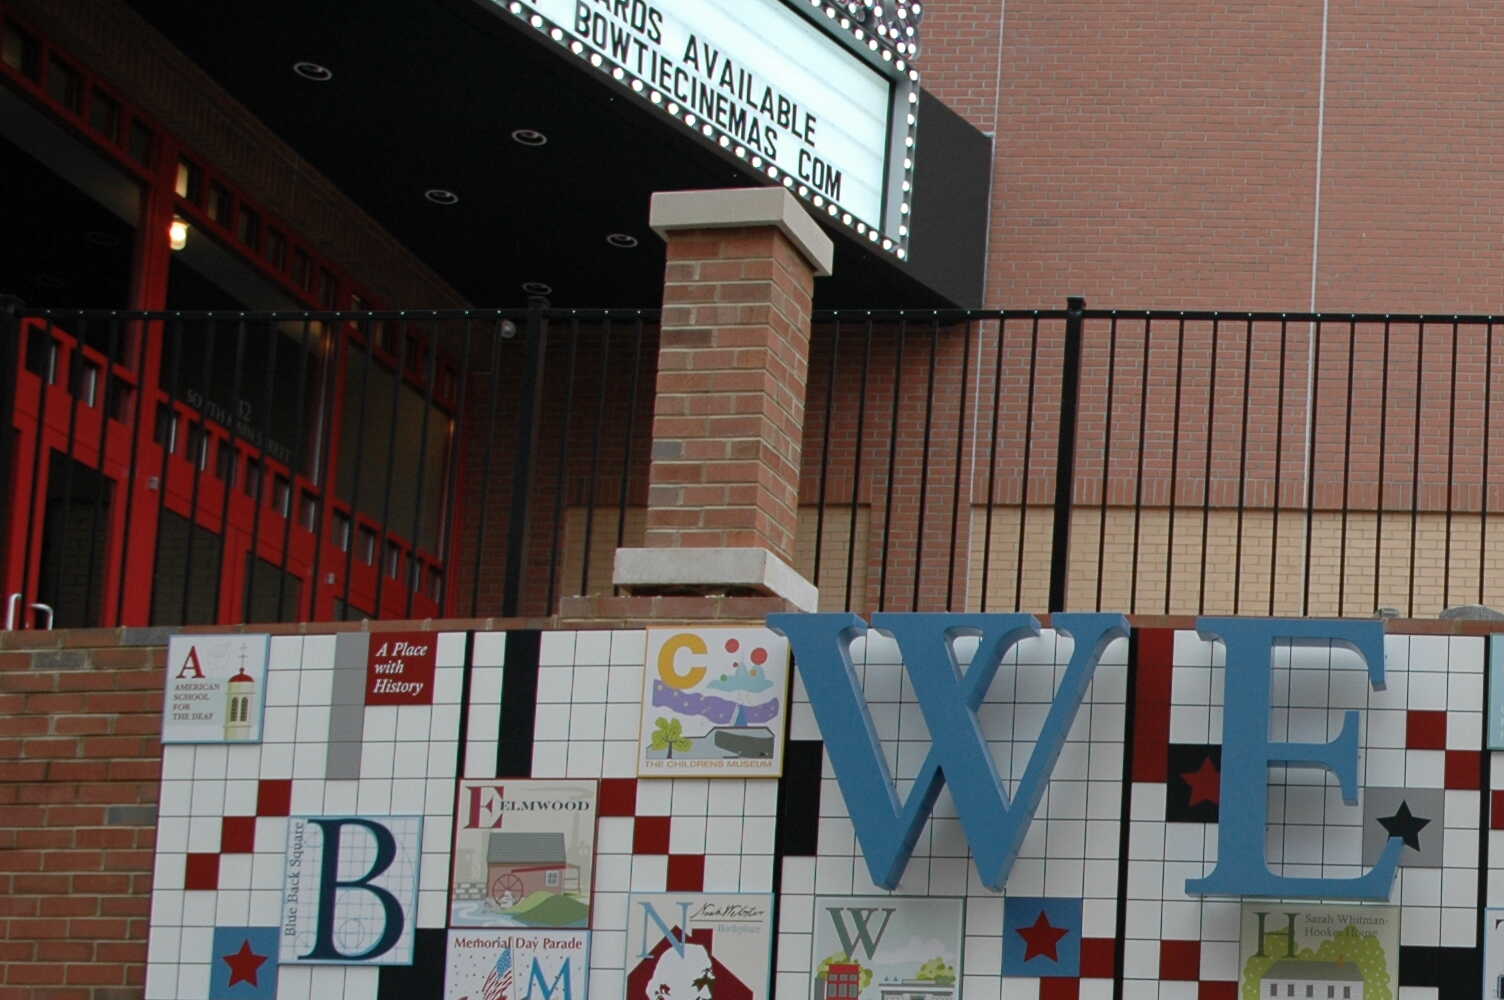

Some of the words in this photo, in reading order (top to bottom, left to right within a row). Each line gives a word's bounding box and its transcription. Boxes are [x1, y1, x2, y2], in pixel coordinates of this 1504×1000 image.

[574, 0, 777, 161] BOWTIECINEMAS
[798, 153, 842, 201] COM
[683, 34, 817, 147] AVAILABLE
[176, 645, 206, 679] A
[374, 659, 406, 674] with
[375, 641, 388, 656] A
[391, 641, 429, 656] Place
[657, 632, 708, 690] C
[373, 678, 425, 697] History
[726, 761, 773, 769] MUSEUM
[463, 785, 505, 830] E
[499, 800, 590, 812] ELMWOOD
[289, 822, 305, 867] Square
[287, 871, 301, 905] Back
[297, 817, 405, 961] B
[284, 907, 298, 937] Blue
[453, 936, 512, 950] Memorial
[515, 937, 540, 952] Day
[542, 937, 583, 951] Parade
[636, 901, 695, 960] N
[825, 906, 897, 961] W
[1253, 911, 1301, 959] H
[1304, 913, 1334, 925] Sarah
